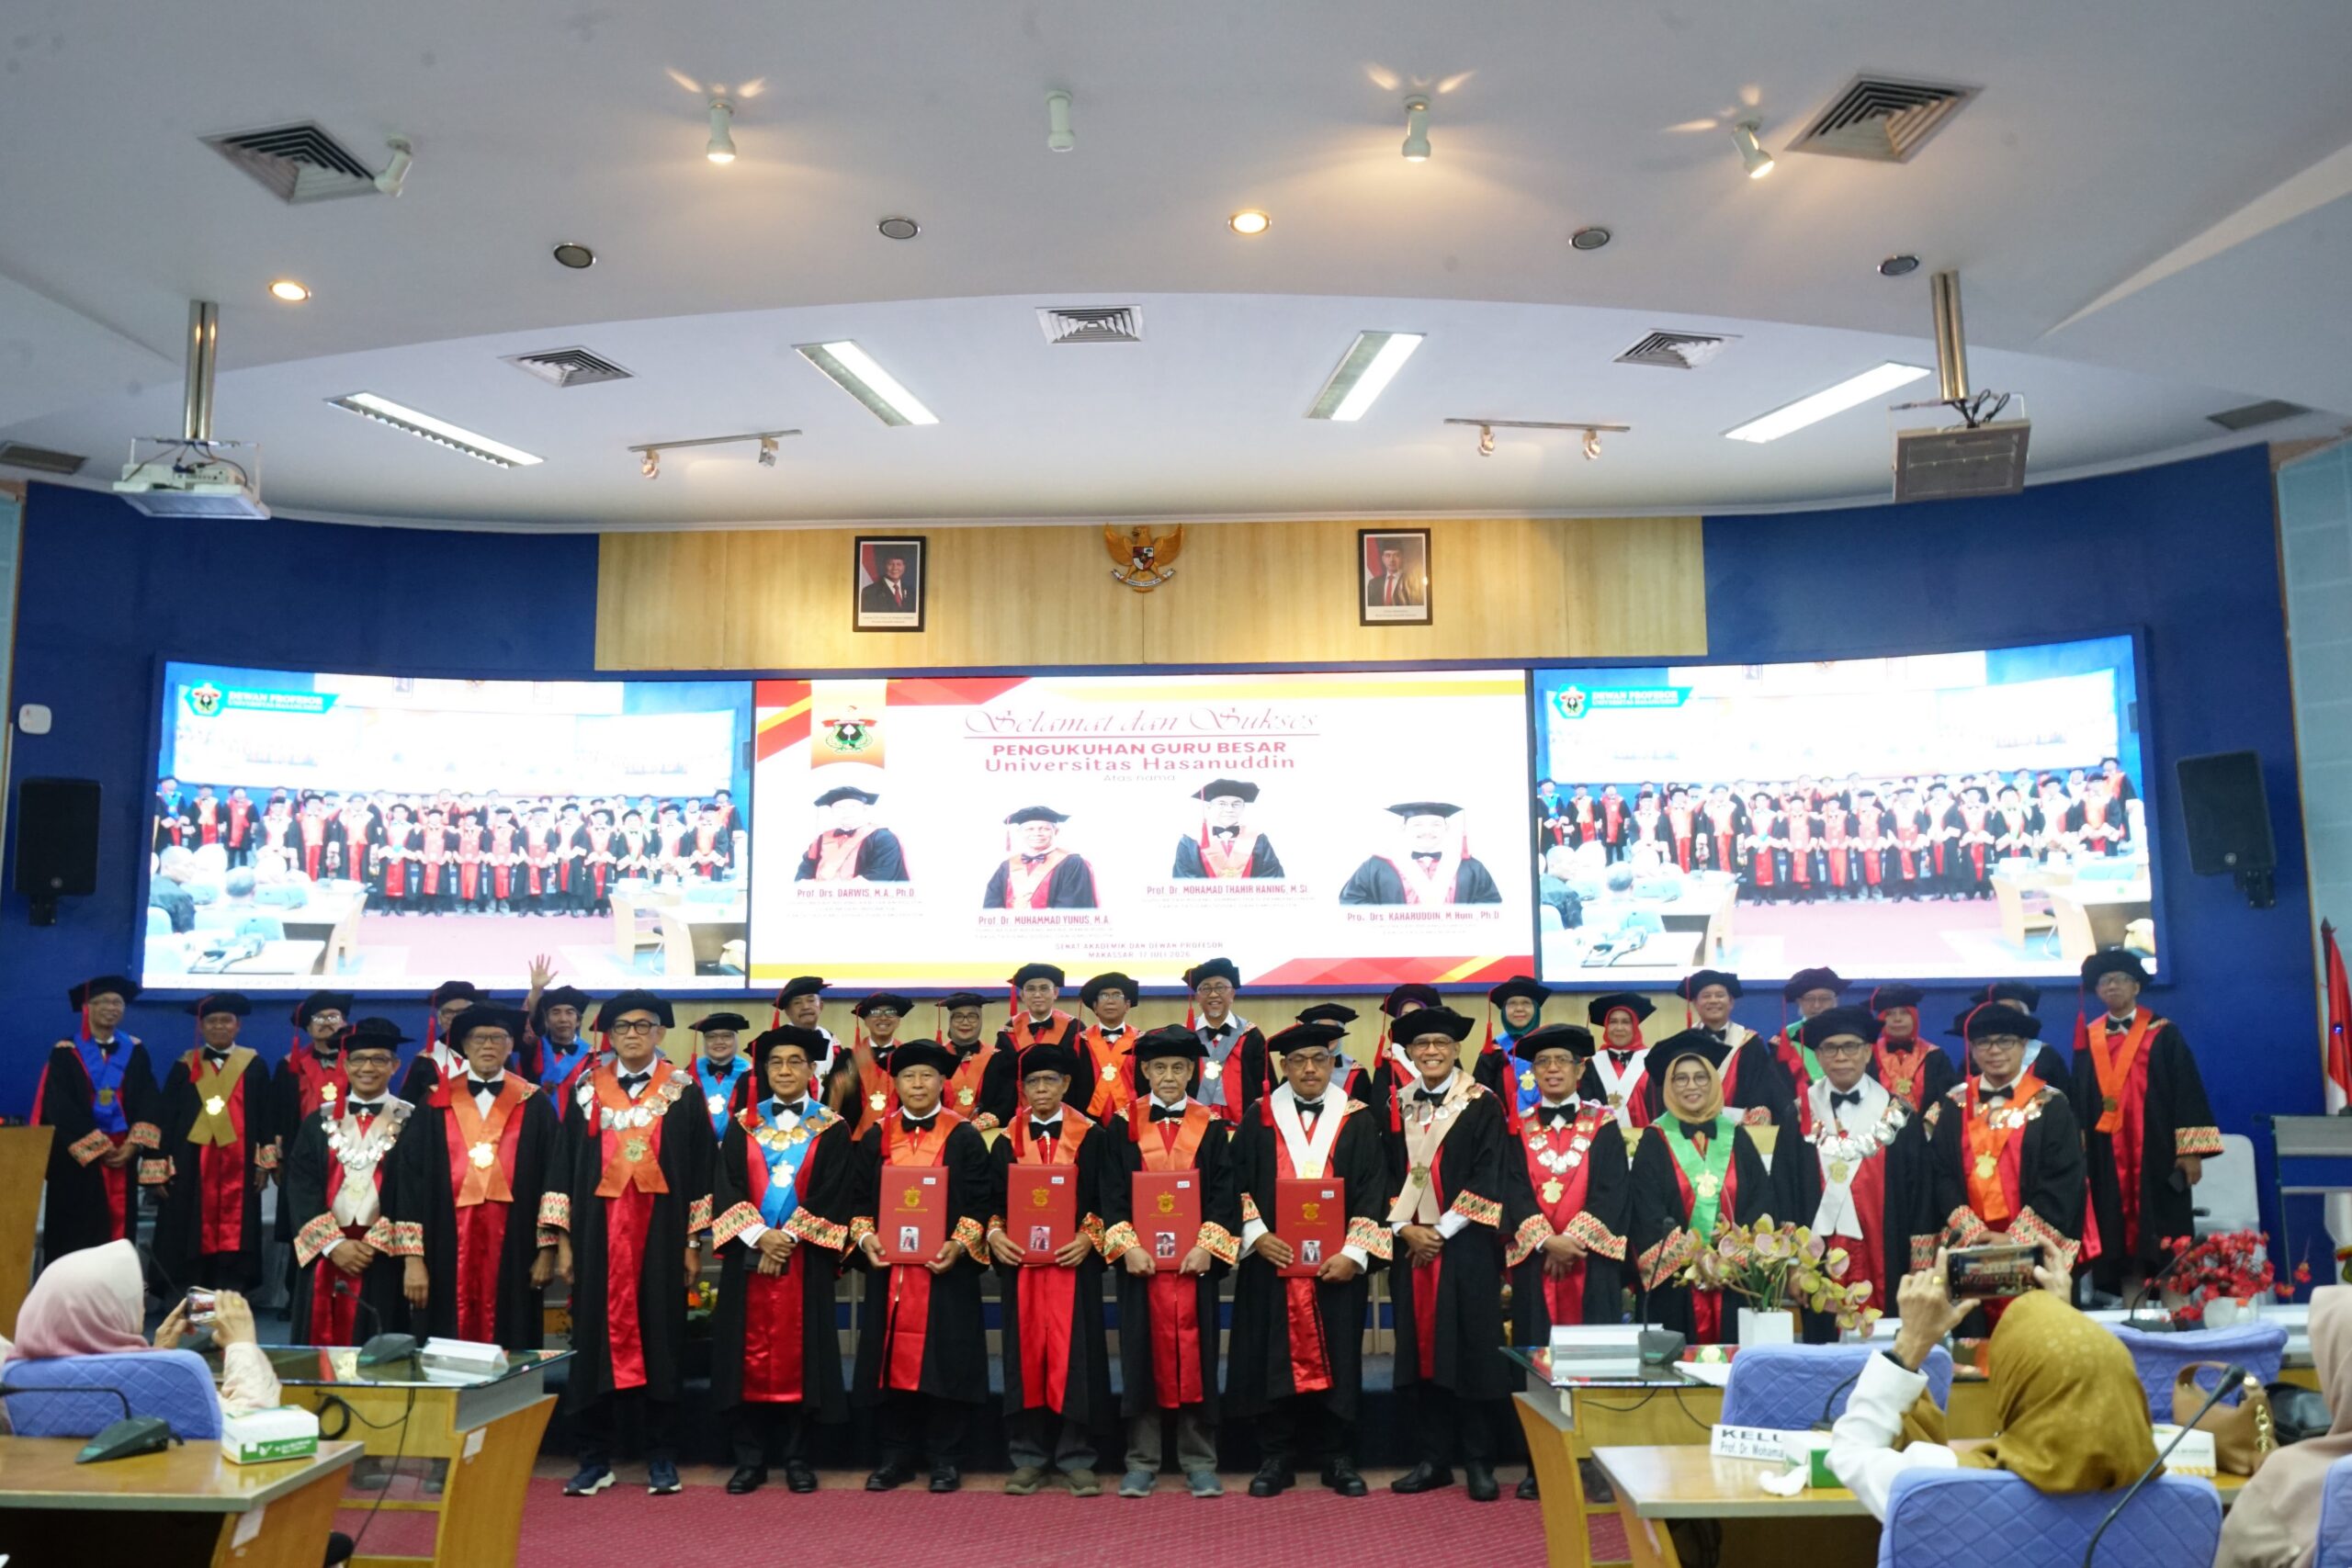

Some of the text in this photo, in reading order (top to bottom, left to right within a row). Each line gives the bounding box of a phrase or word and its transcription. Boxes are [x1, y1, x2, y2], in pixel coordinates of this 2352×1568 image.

[966, 707, 1317, 733] Selamat dan Sukses
[992, 741, 1287, 756] PENGUKUHAN GURU BESAR
[985, 755, 1295, 773] Universitas Hasanuddin
[1183, 885, 1223, 895] MOHAMAD
[1014, 915, 1060, 925] MUHAMMAD
